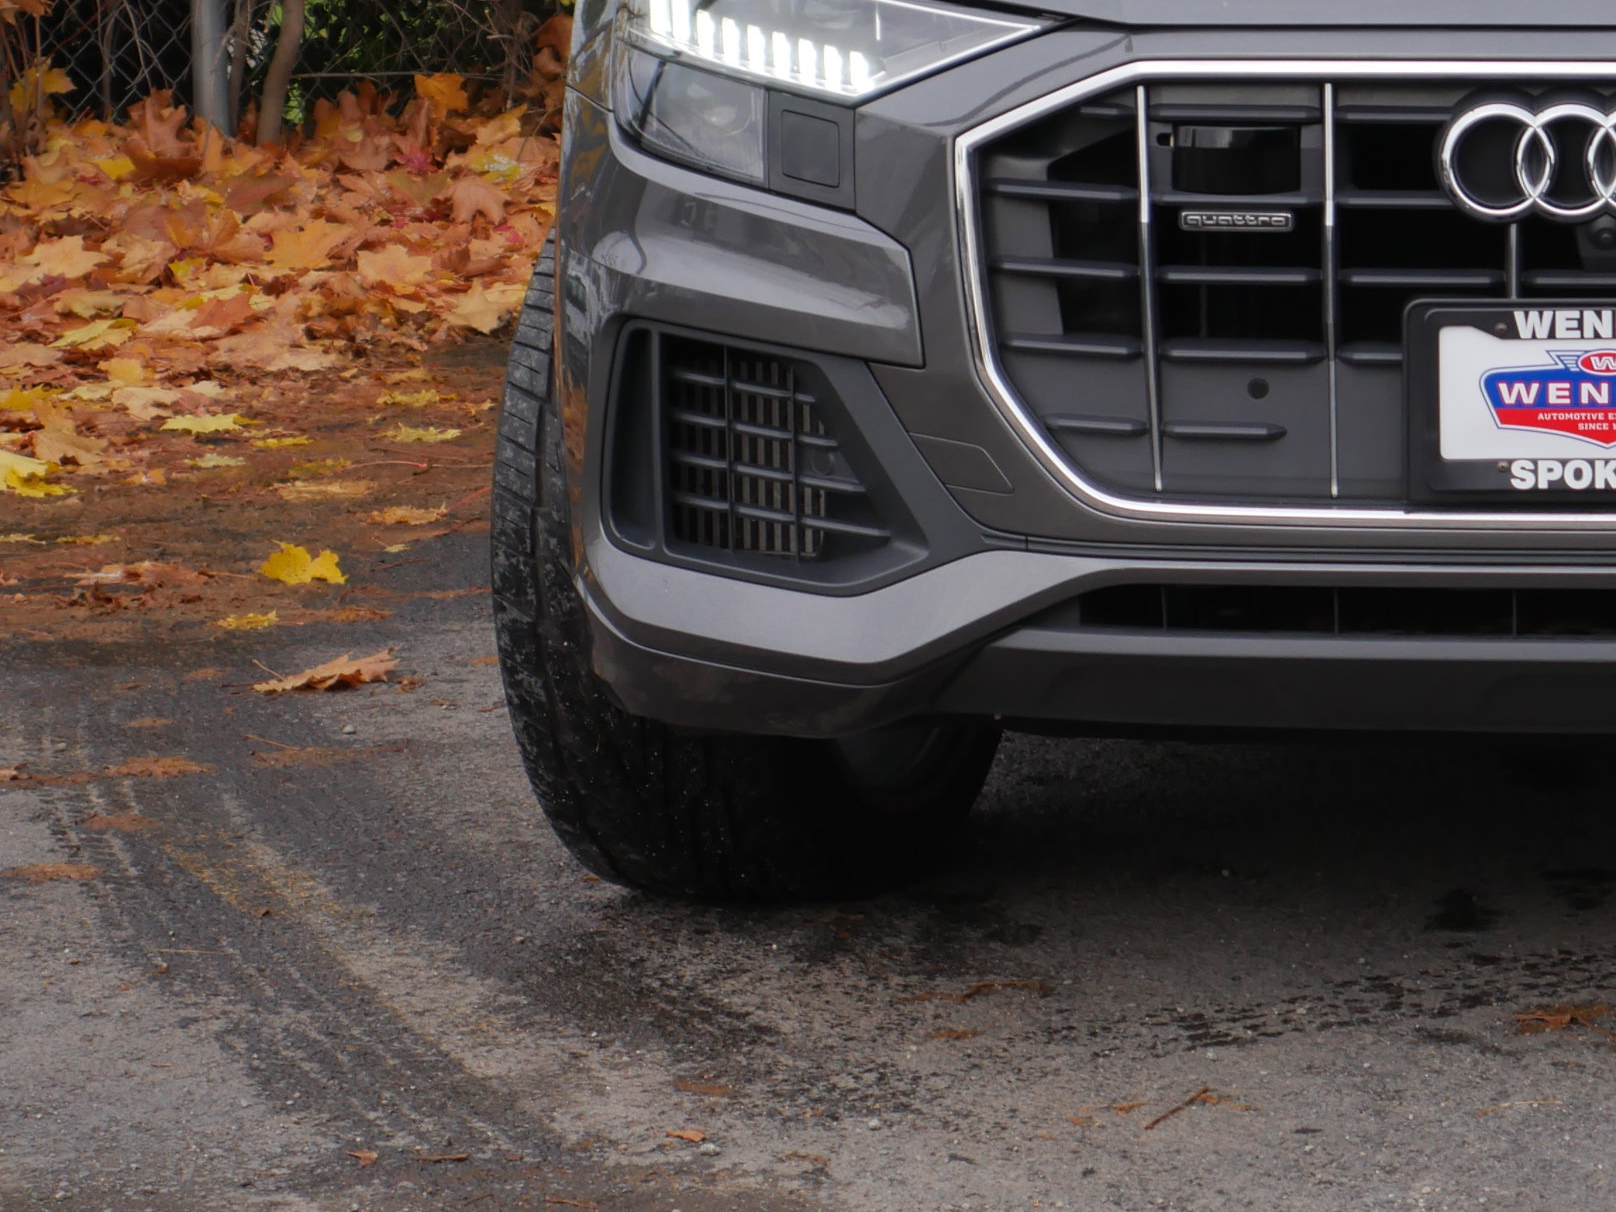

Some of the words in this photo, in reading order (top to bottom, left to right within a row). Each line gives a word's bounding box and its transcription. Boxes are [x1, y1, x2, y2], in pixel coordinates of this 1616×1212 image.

[1186, 215, 1286, 226] quattro
[1537, 412, 1605, 421] AUTOMOTIVE
[1578, 422, 1609, 430] SINCE
